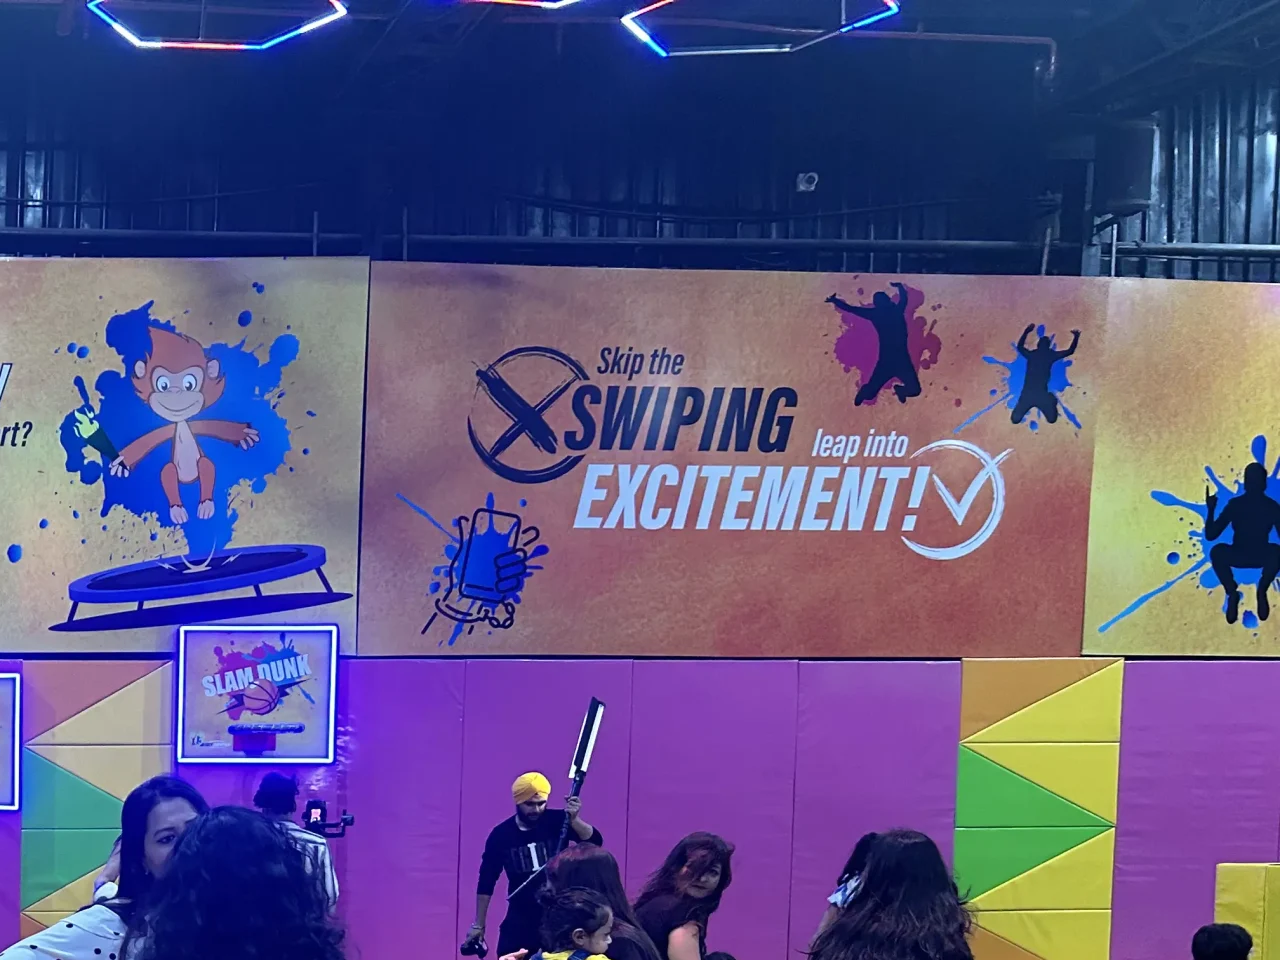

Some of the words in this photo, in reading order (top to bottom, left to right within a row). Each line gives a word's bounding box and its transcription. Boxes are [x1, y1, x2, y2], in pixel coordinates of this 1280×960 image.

[597, 346, 644, 381] Skip
[649, 348, 685, 375] the
[564, 384, 798, 453] SWIPING
[811, 428, 859, 463] leap
[864, 430, 910, 458] into
[573, 463, 931, 532] EXCITEMENT!
[202, 667, 254, 697] SLAM
[257, 654, 313, 682] DUNK
